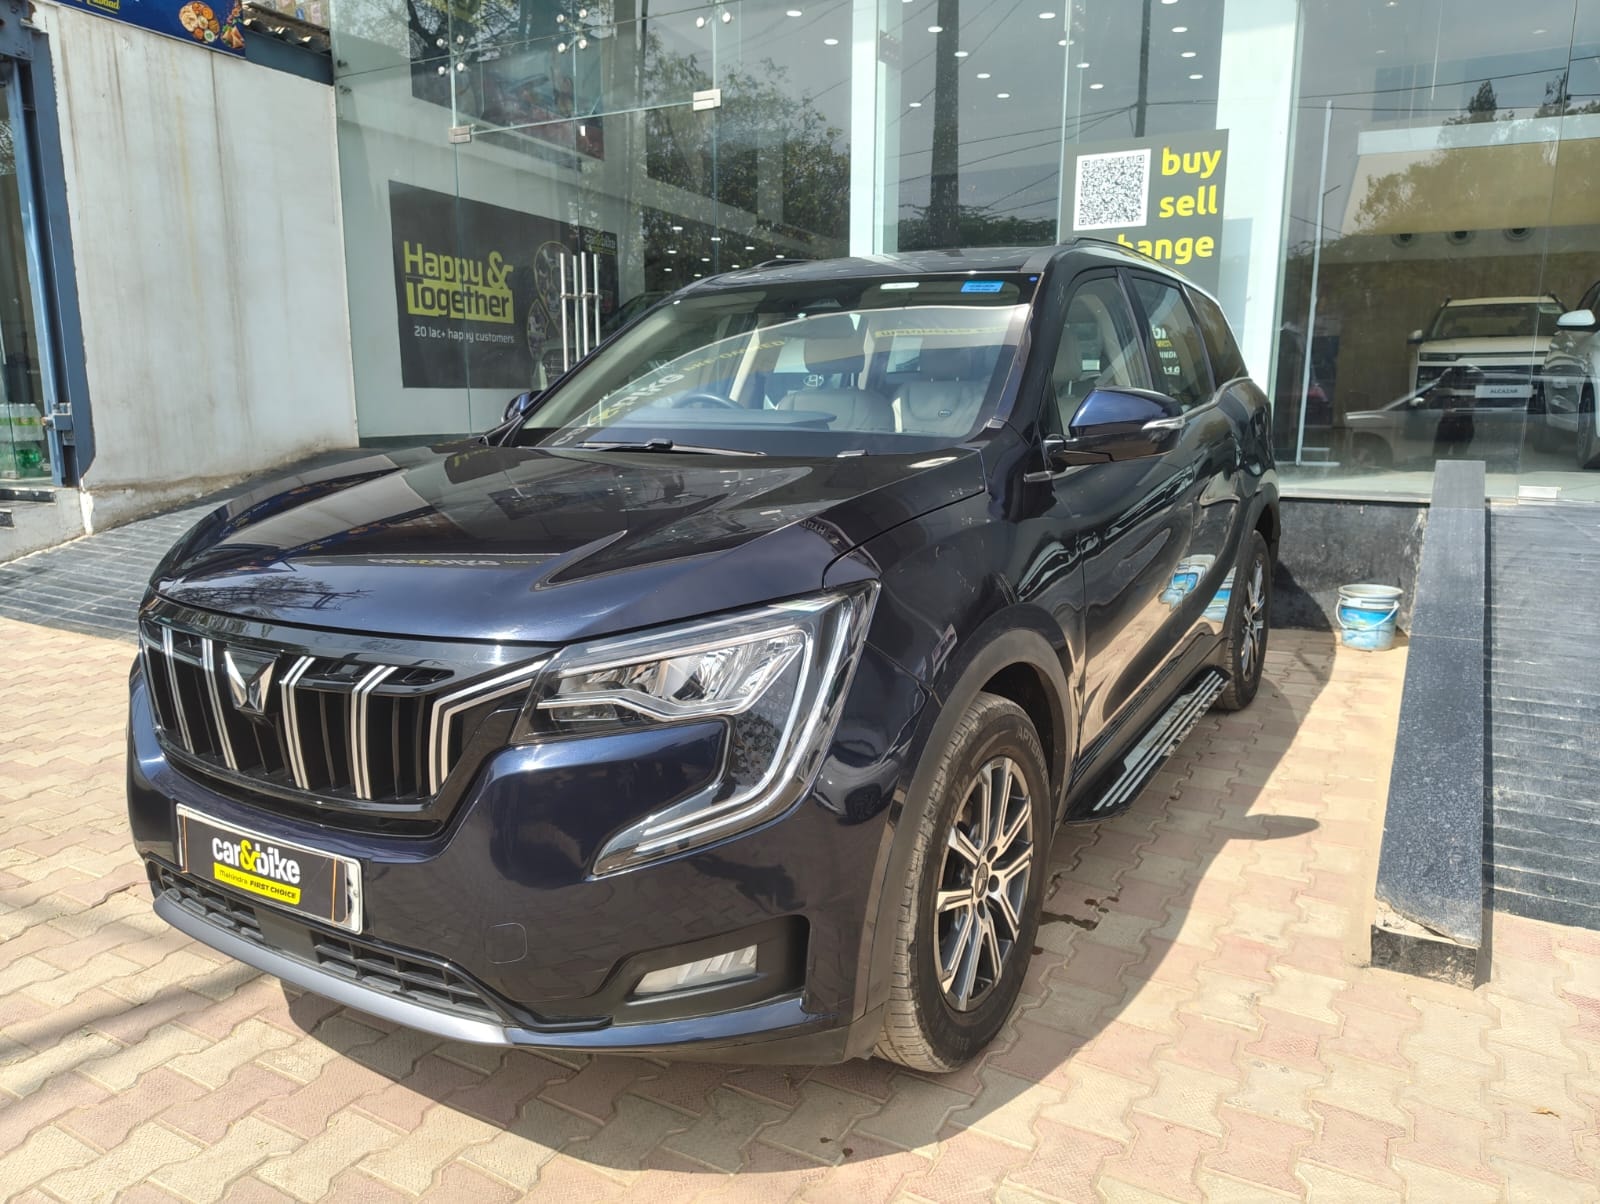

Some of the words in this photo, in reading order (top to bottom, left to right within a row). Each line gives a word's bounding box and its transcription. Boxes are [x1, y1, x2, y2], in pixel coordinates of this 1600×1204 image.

[1161, 146, 1222, 179] buy
[1159, 185, 1218, 218] sell
[404, 240, 484, 287] Happy
[487, 250, 514, 290] &
[407, 277, 510, 318] Together
[414, 325, 427, 337] 20
[429, 326, 446, 339] lac+
[475, 332, 514, 344] customers
[212, 837, 301, 885] car&bike
[219, 869, 248, 885] mahindra
[249, 880, 269, 892] FIRST
[270, 887, 297, 899] CHOICE
